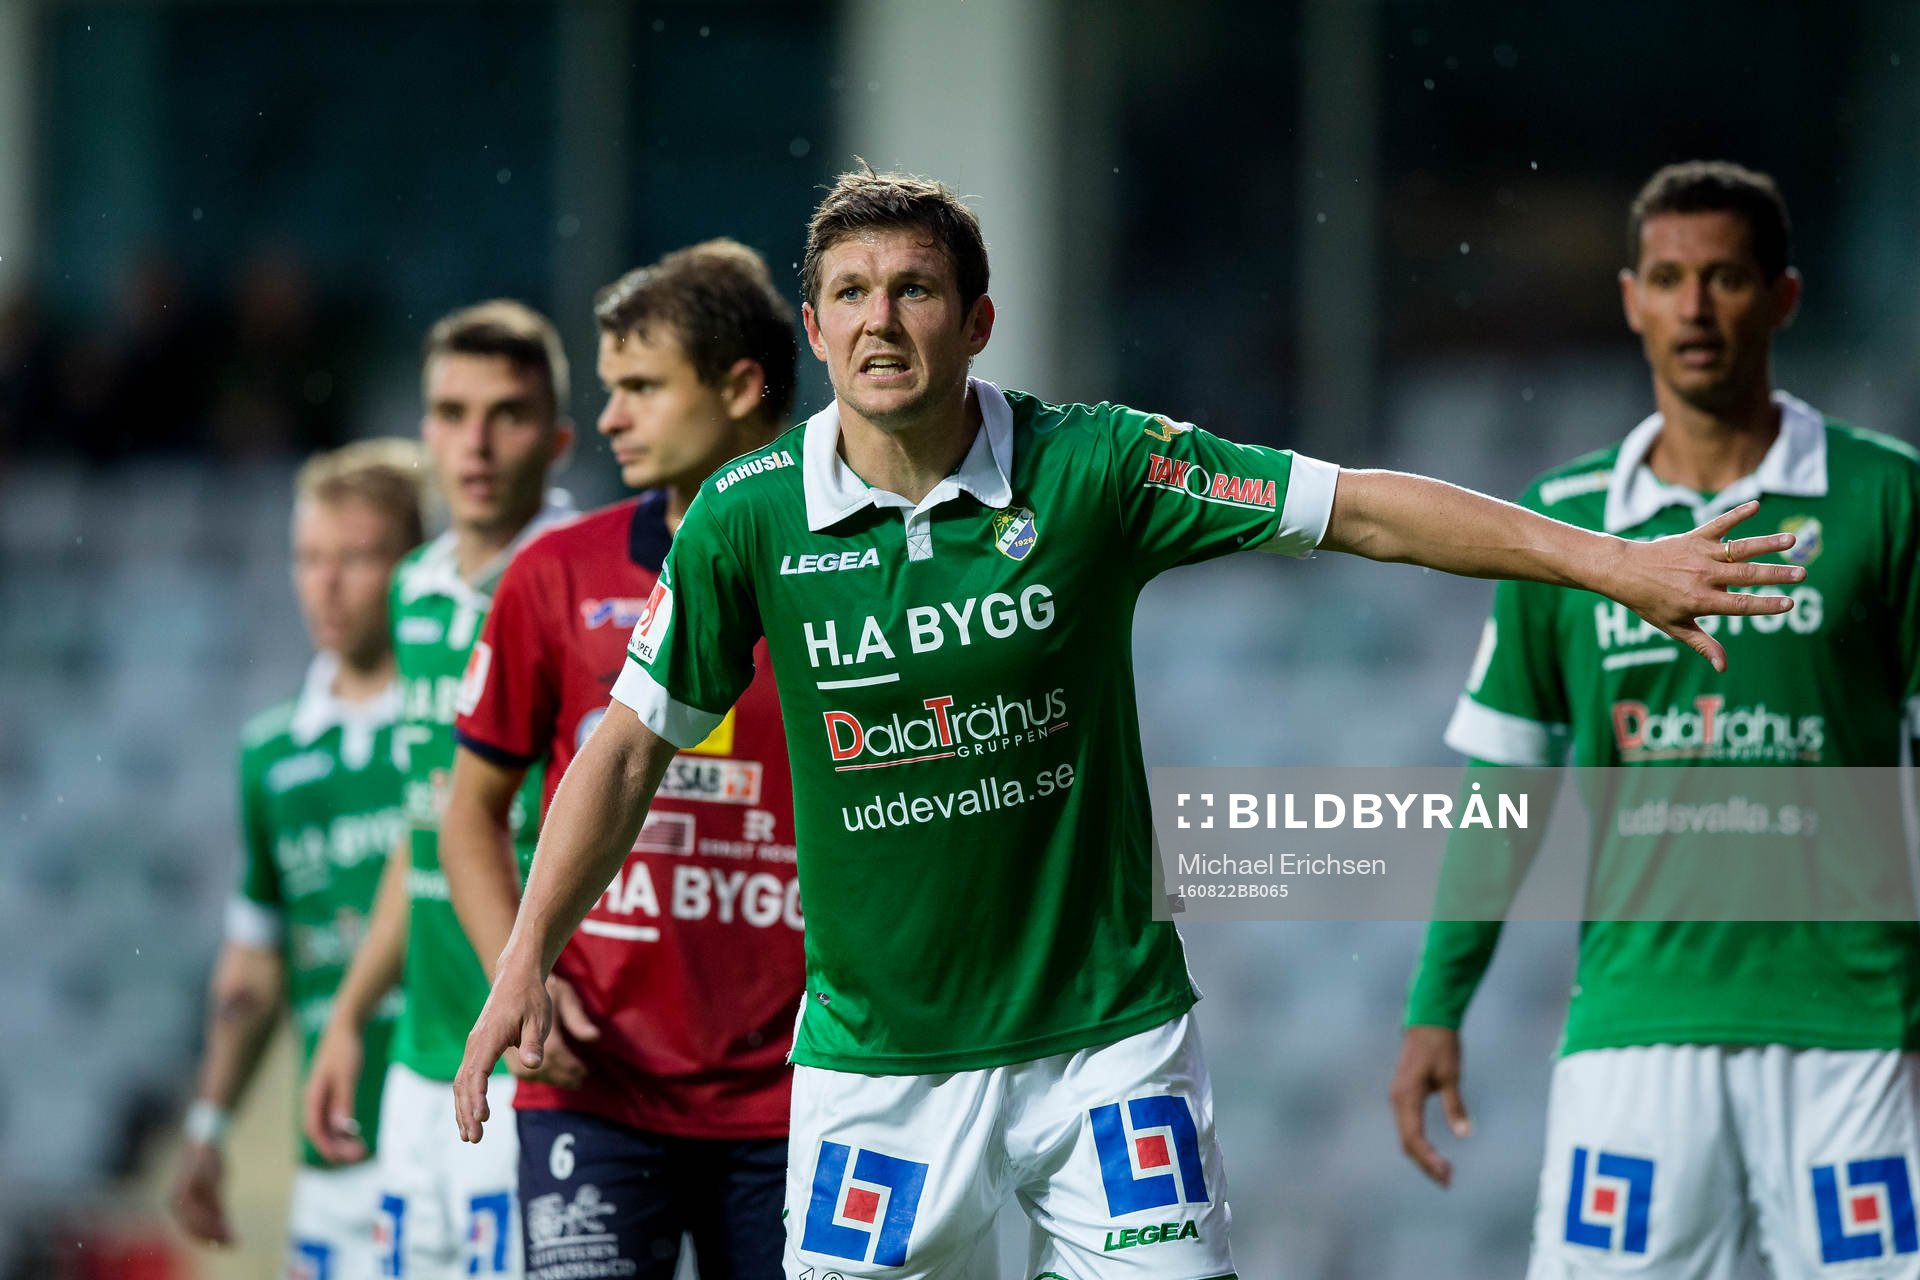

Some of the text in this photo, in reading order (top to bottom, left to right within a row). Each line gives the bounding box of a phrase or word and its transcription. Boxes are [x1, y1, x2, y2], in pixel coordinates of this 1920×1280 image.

[715, 450, 795, 494] BAHUSIA
[780, 547, 880, 576] LEGEA
[803, 583, 1056, 668] H.A BYGG
[823, 688, 1068, 761] DalaTrähus
[957, 726, 1049, 758] GRUPPEN
[842, 763, 1075, 832] uddevalla.se
[549, 1132, 575, 1180] 6
[1104, 1220, 1199, 1252] LEGEA
